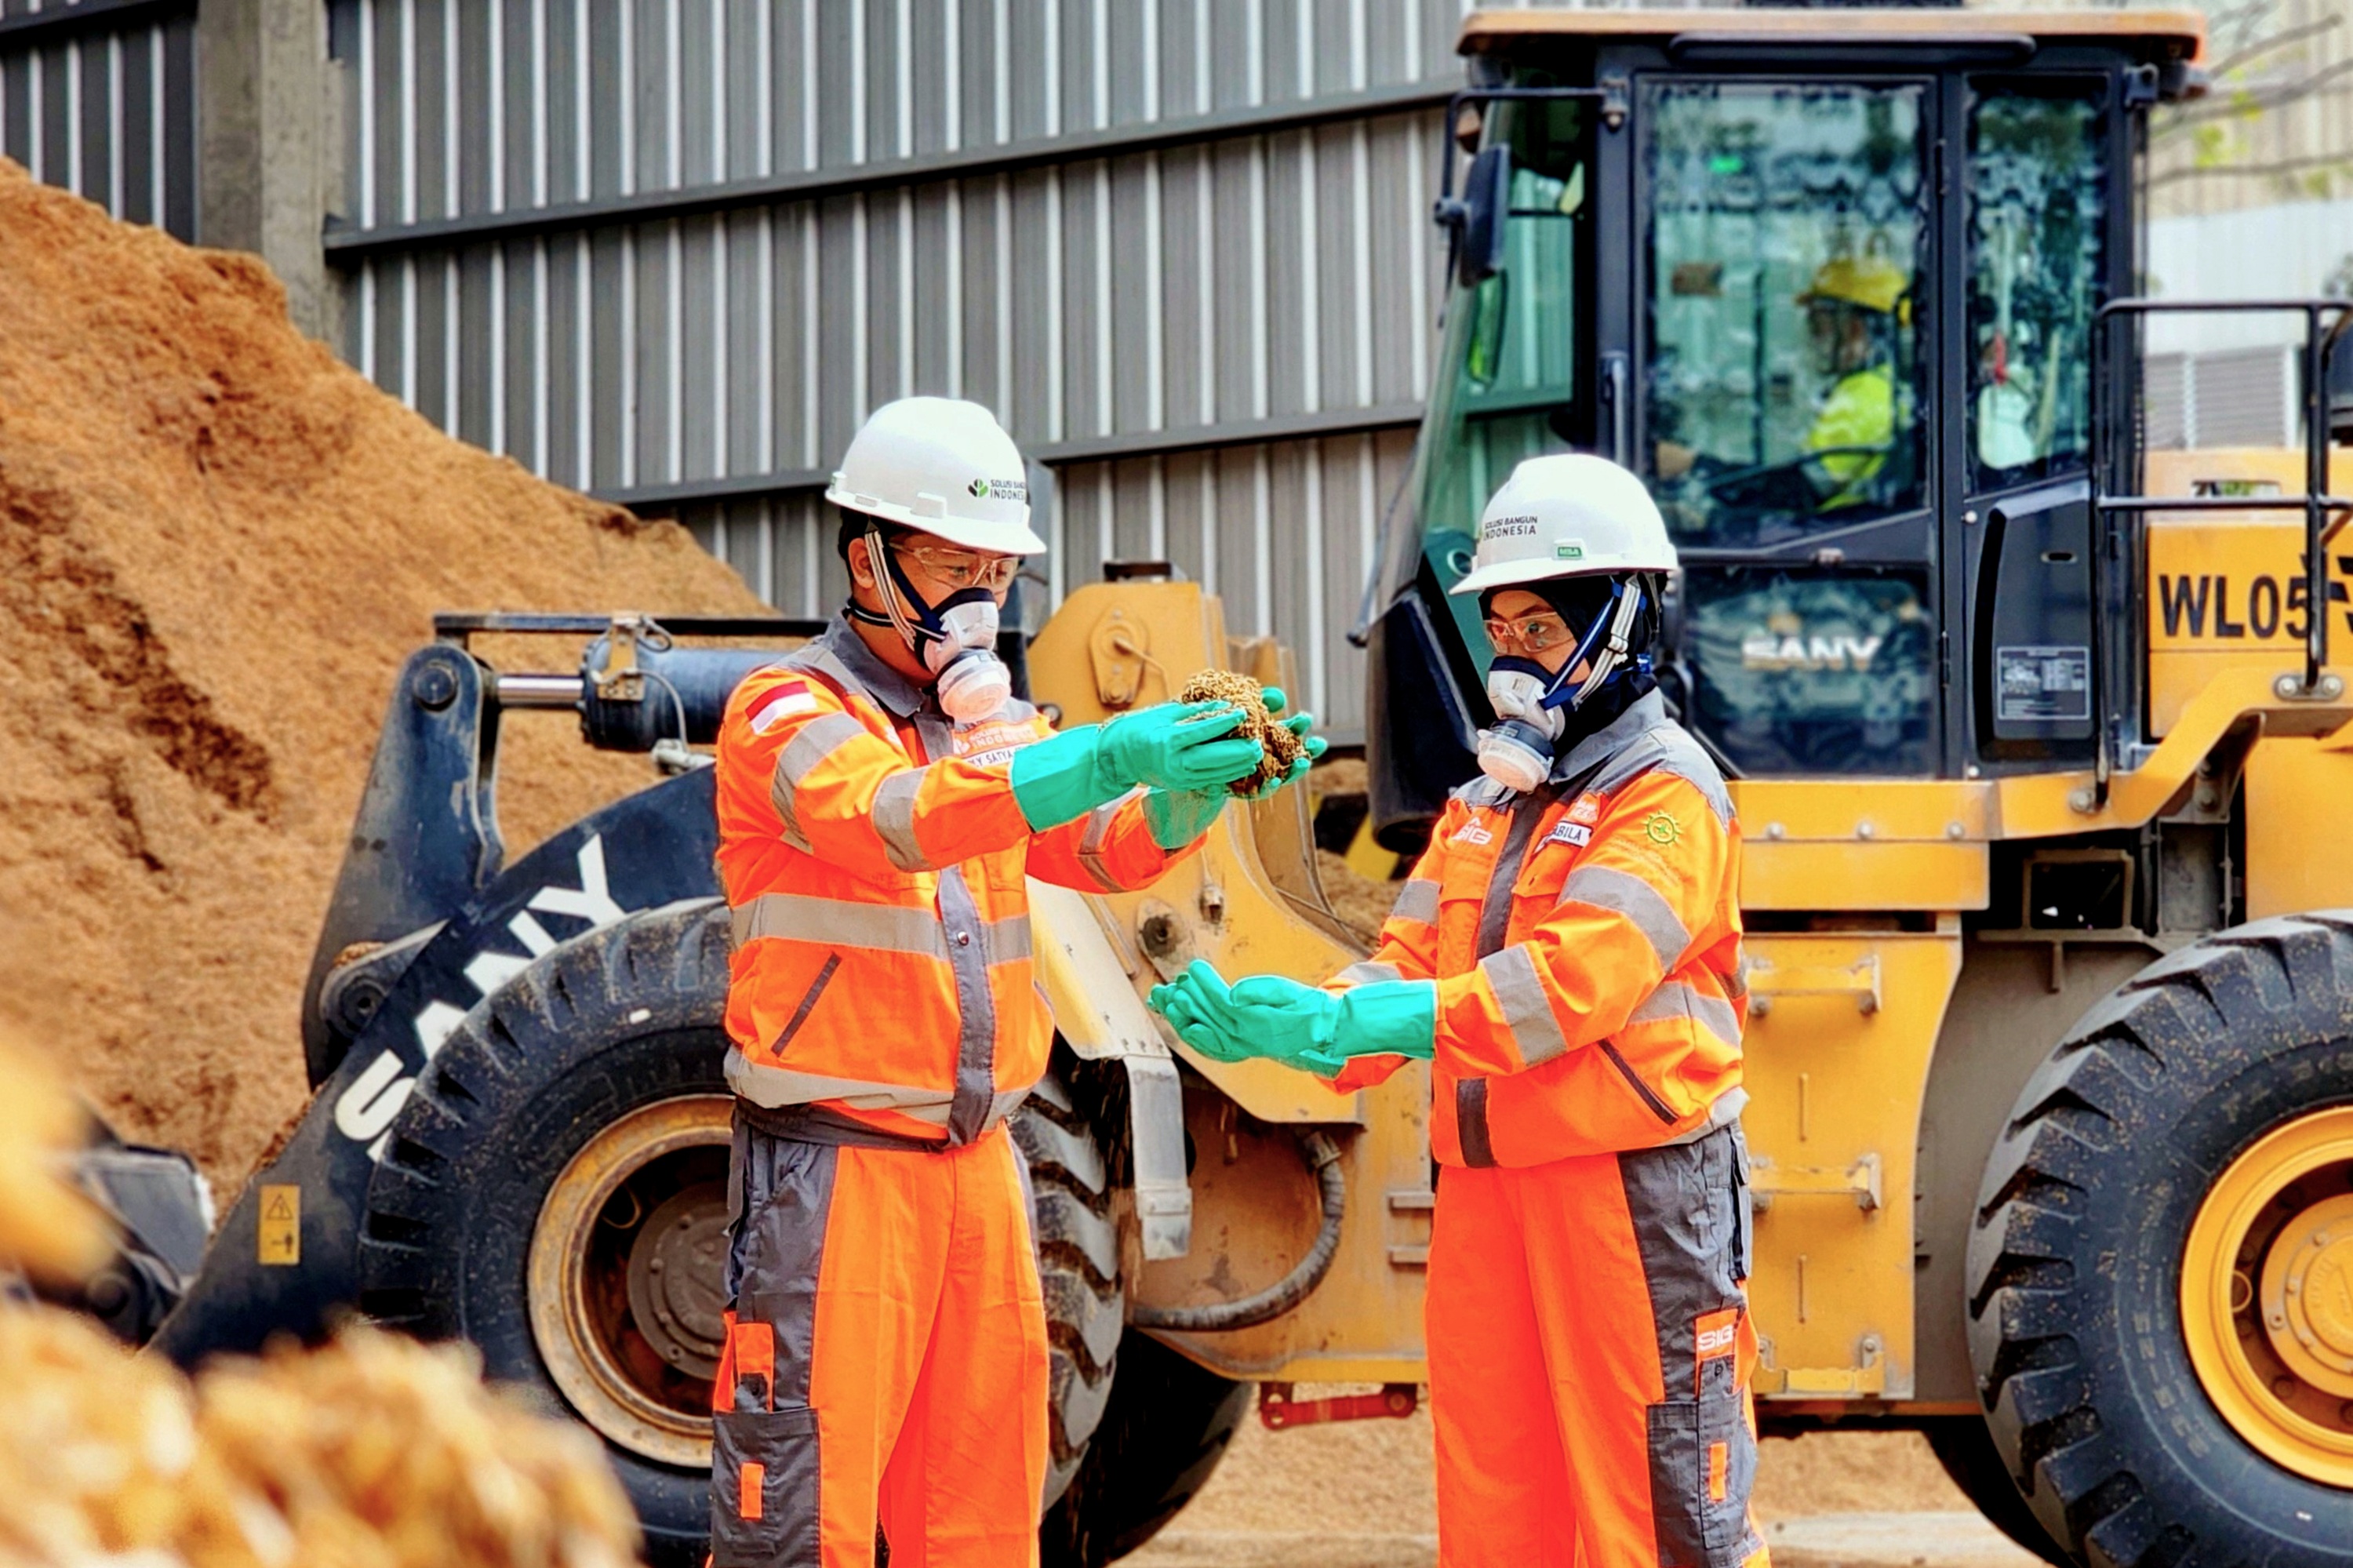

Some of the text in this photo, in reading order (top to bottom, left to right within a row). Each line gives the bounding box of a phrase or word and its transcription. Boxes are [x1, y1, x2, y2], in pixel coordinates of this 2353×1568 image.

[1504, 515, 1537, 526] BANGUN
[1742, 636, 1881, 671] SANY
[986, 749, 1013, 764] SATYA
[1697, 1324, 1733, 1352] SIG
